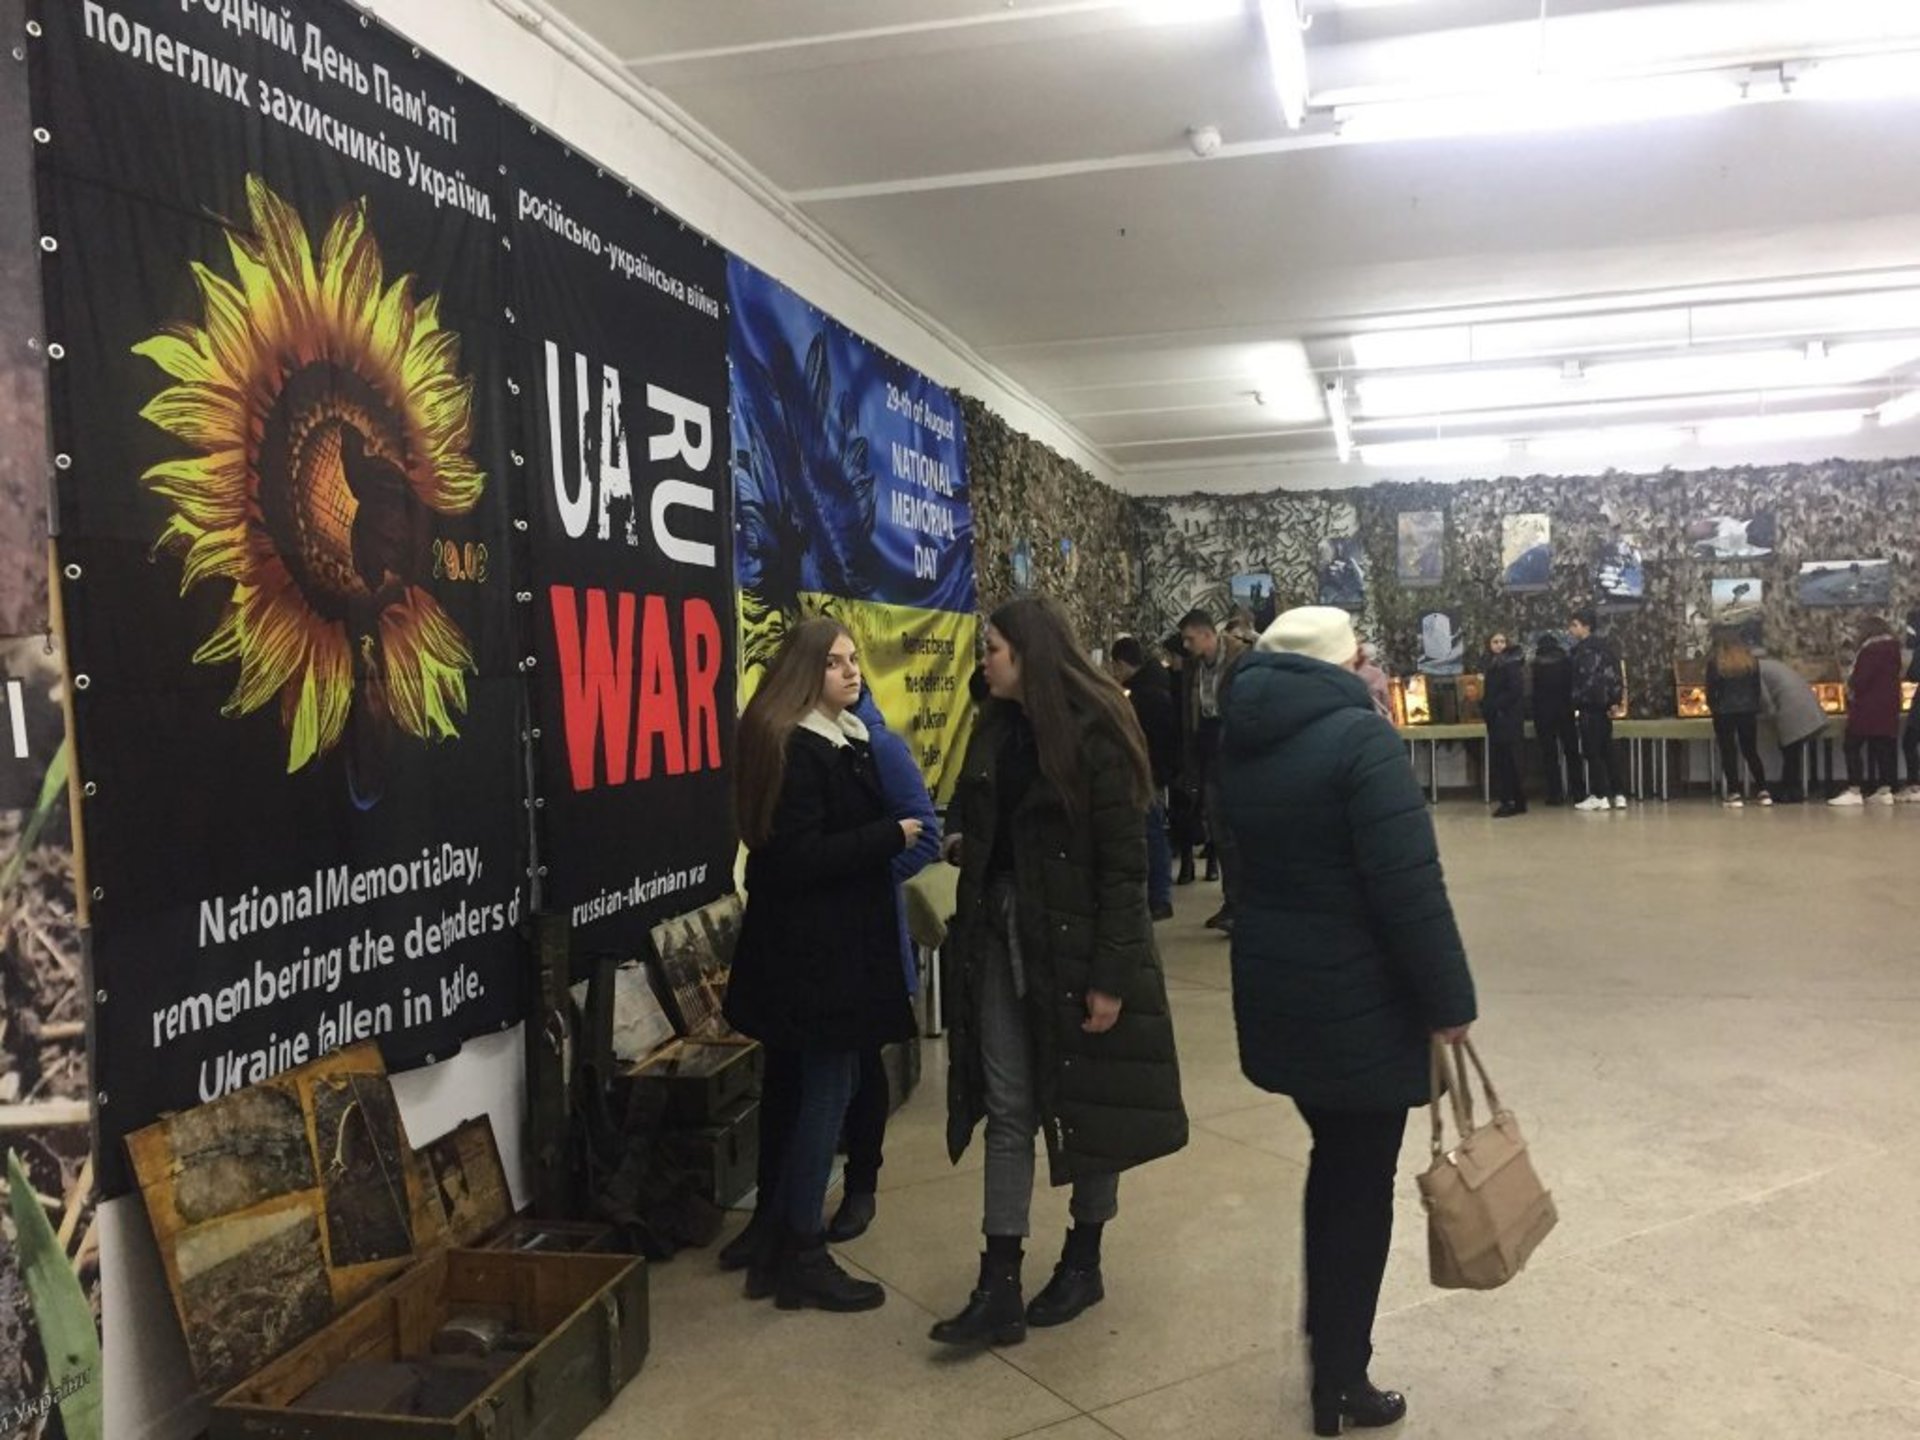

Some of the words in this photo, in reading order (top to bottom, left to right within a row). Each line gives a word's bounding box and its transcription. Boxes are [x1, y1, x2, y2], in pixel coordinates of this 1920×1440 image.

[84, 0, 251, 107] полеглих
[258, 79, 401, 179] захисників
[405, 146, 496, 223] України.
[181, 0, 297, 56] дний
[302, 22, 369, 93] День
[373, 63, 457, 144] Пам'яті
[519, 188, 601, 255] російсько
[603, 242, 685, 301] -українська
[687, 284, 719, 320] війна
[545, 340, 639, 546] UA
[647, 383, 716, 567] RU
[892, 441, 953, 498] NATIONAL
[914, 544, 938, 582] DAY
[550, 584, 722, 791] WAR
[199, 869, 323, 948] National
[325, 842, 444, 911] Memoria
[572, 867, 687, 928] russian-kranan
[152, 945, 342, 1048] remembering
[349, 928, 395, 974] the
[404, 900, 505, 959] denders
[317, 1000, 393, 1056] fallen
[403, 987, 432, 1028] in
[440, 963, 485, 1018] btle.
